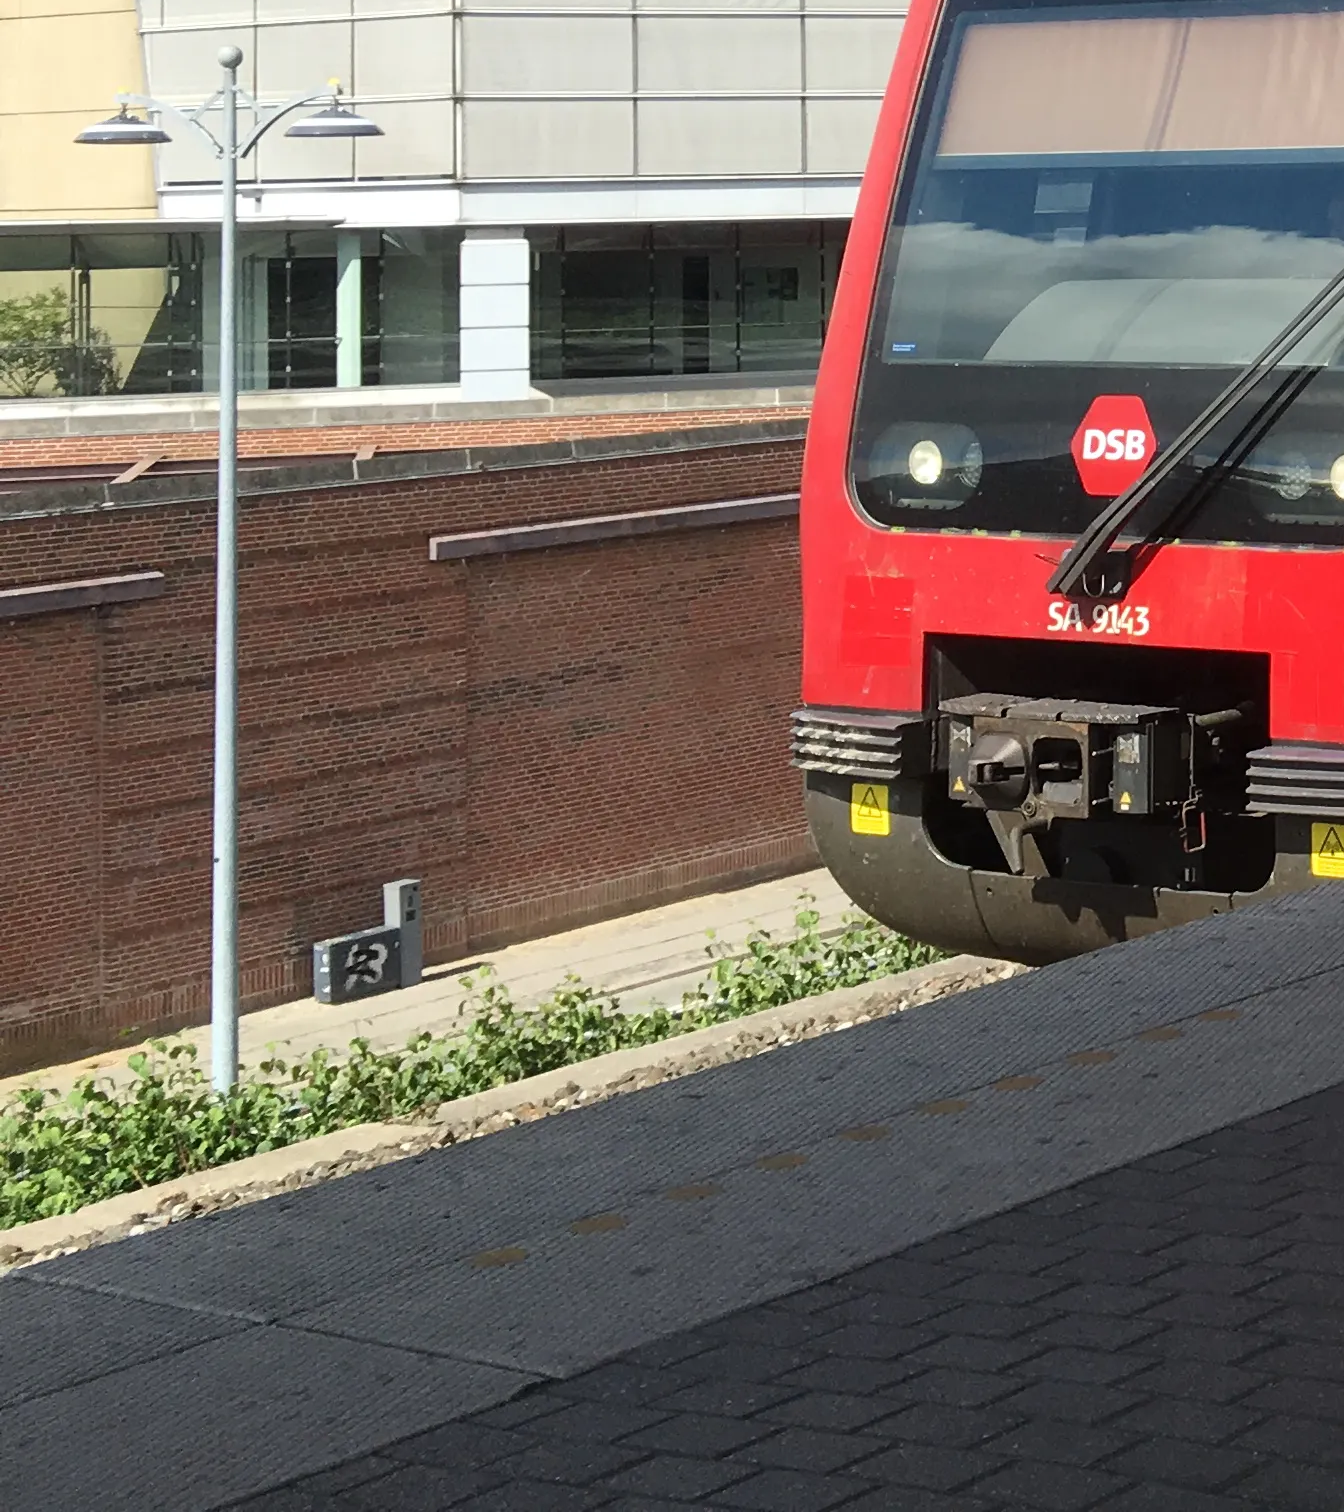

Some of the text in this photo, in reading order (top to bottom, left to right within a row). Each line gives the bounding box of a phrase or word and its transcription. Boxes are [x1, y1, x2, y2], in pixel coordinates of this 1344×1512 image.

[1081, 428, 1147, 461] DSB
[1047, 601, 1151, 637] SA 9143
